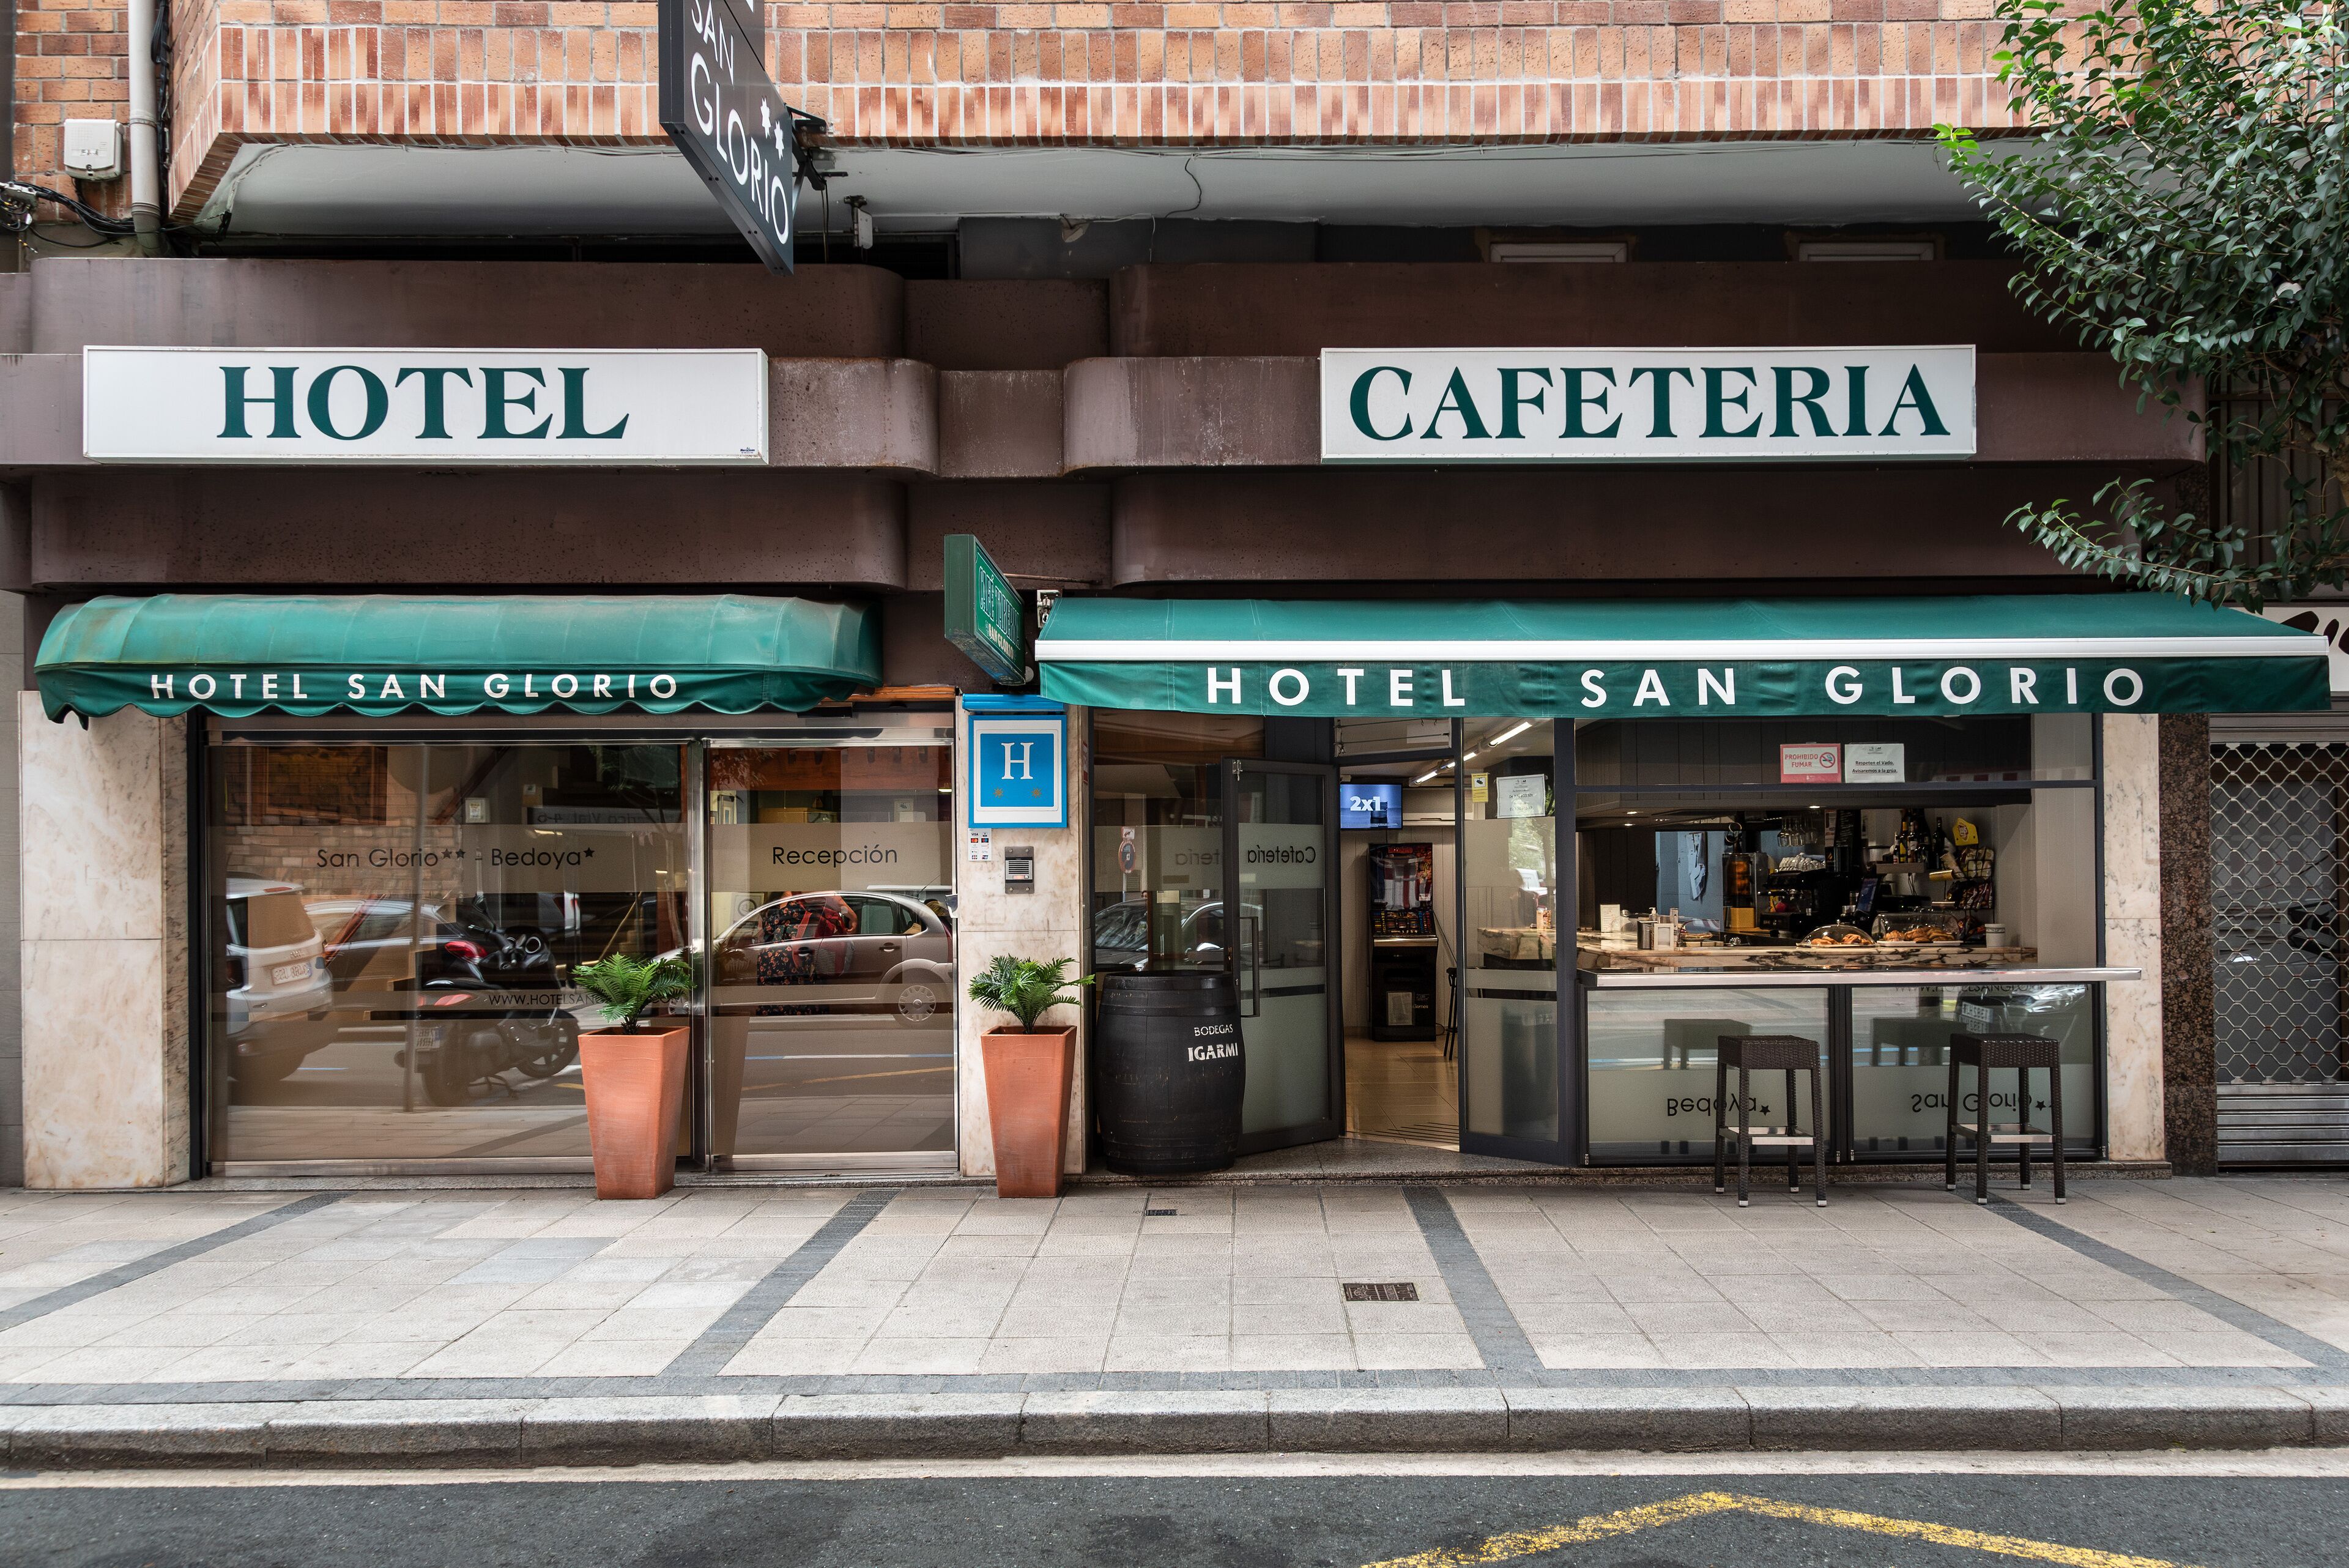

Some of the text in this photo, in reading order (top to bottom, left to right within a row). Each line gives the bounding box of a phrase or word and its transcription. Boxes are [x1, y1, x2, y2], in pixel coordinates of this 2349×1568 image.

[691, 52, 789, 245] GLORIO
[217, 365, 629, 440] HOTEL
[1349, 363, 1951, 440] CAFETERIA
[989, 623, 1014, 660] SAN GLORIO
[150, 673, 677, 699] HOTEL SAN GLORIO
[1208, 666, 2143, 708] HOTEL SAN GLORIO
[1001, 742, 1034, 779] H
[1350, 796, 1381, 811] 2x1
[317, 849, 359, 868] San
[369, 848, 438, 868] Glorio
[491, 848, 581, 869] Bedoya
[773, 844, 898, 868] Recepción
[1194, 1024, 1233, 1036] BODEGAS
[1188, 1042, 1238, 1061] IGARMI
